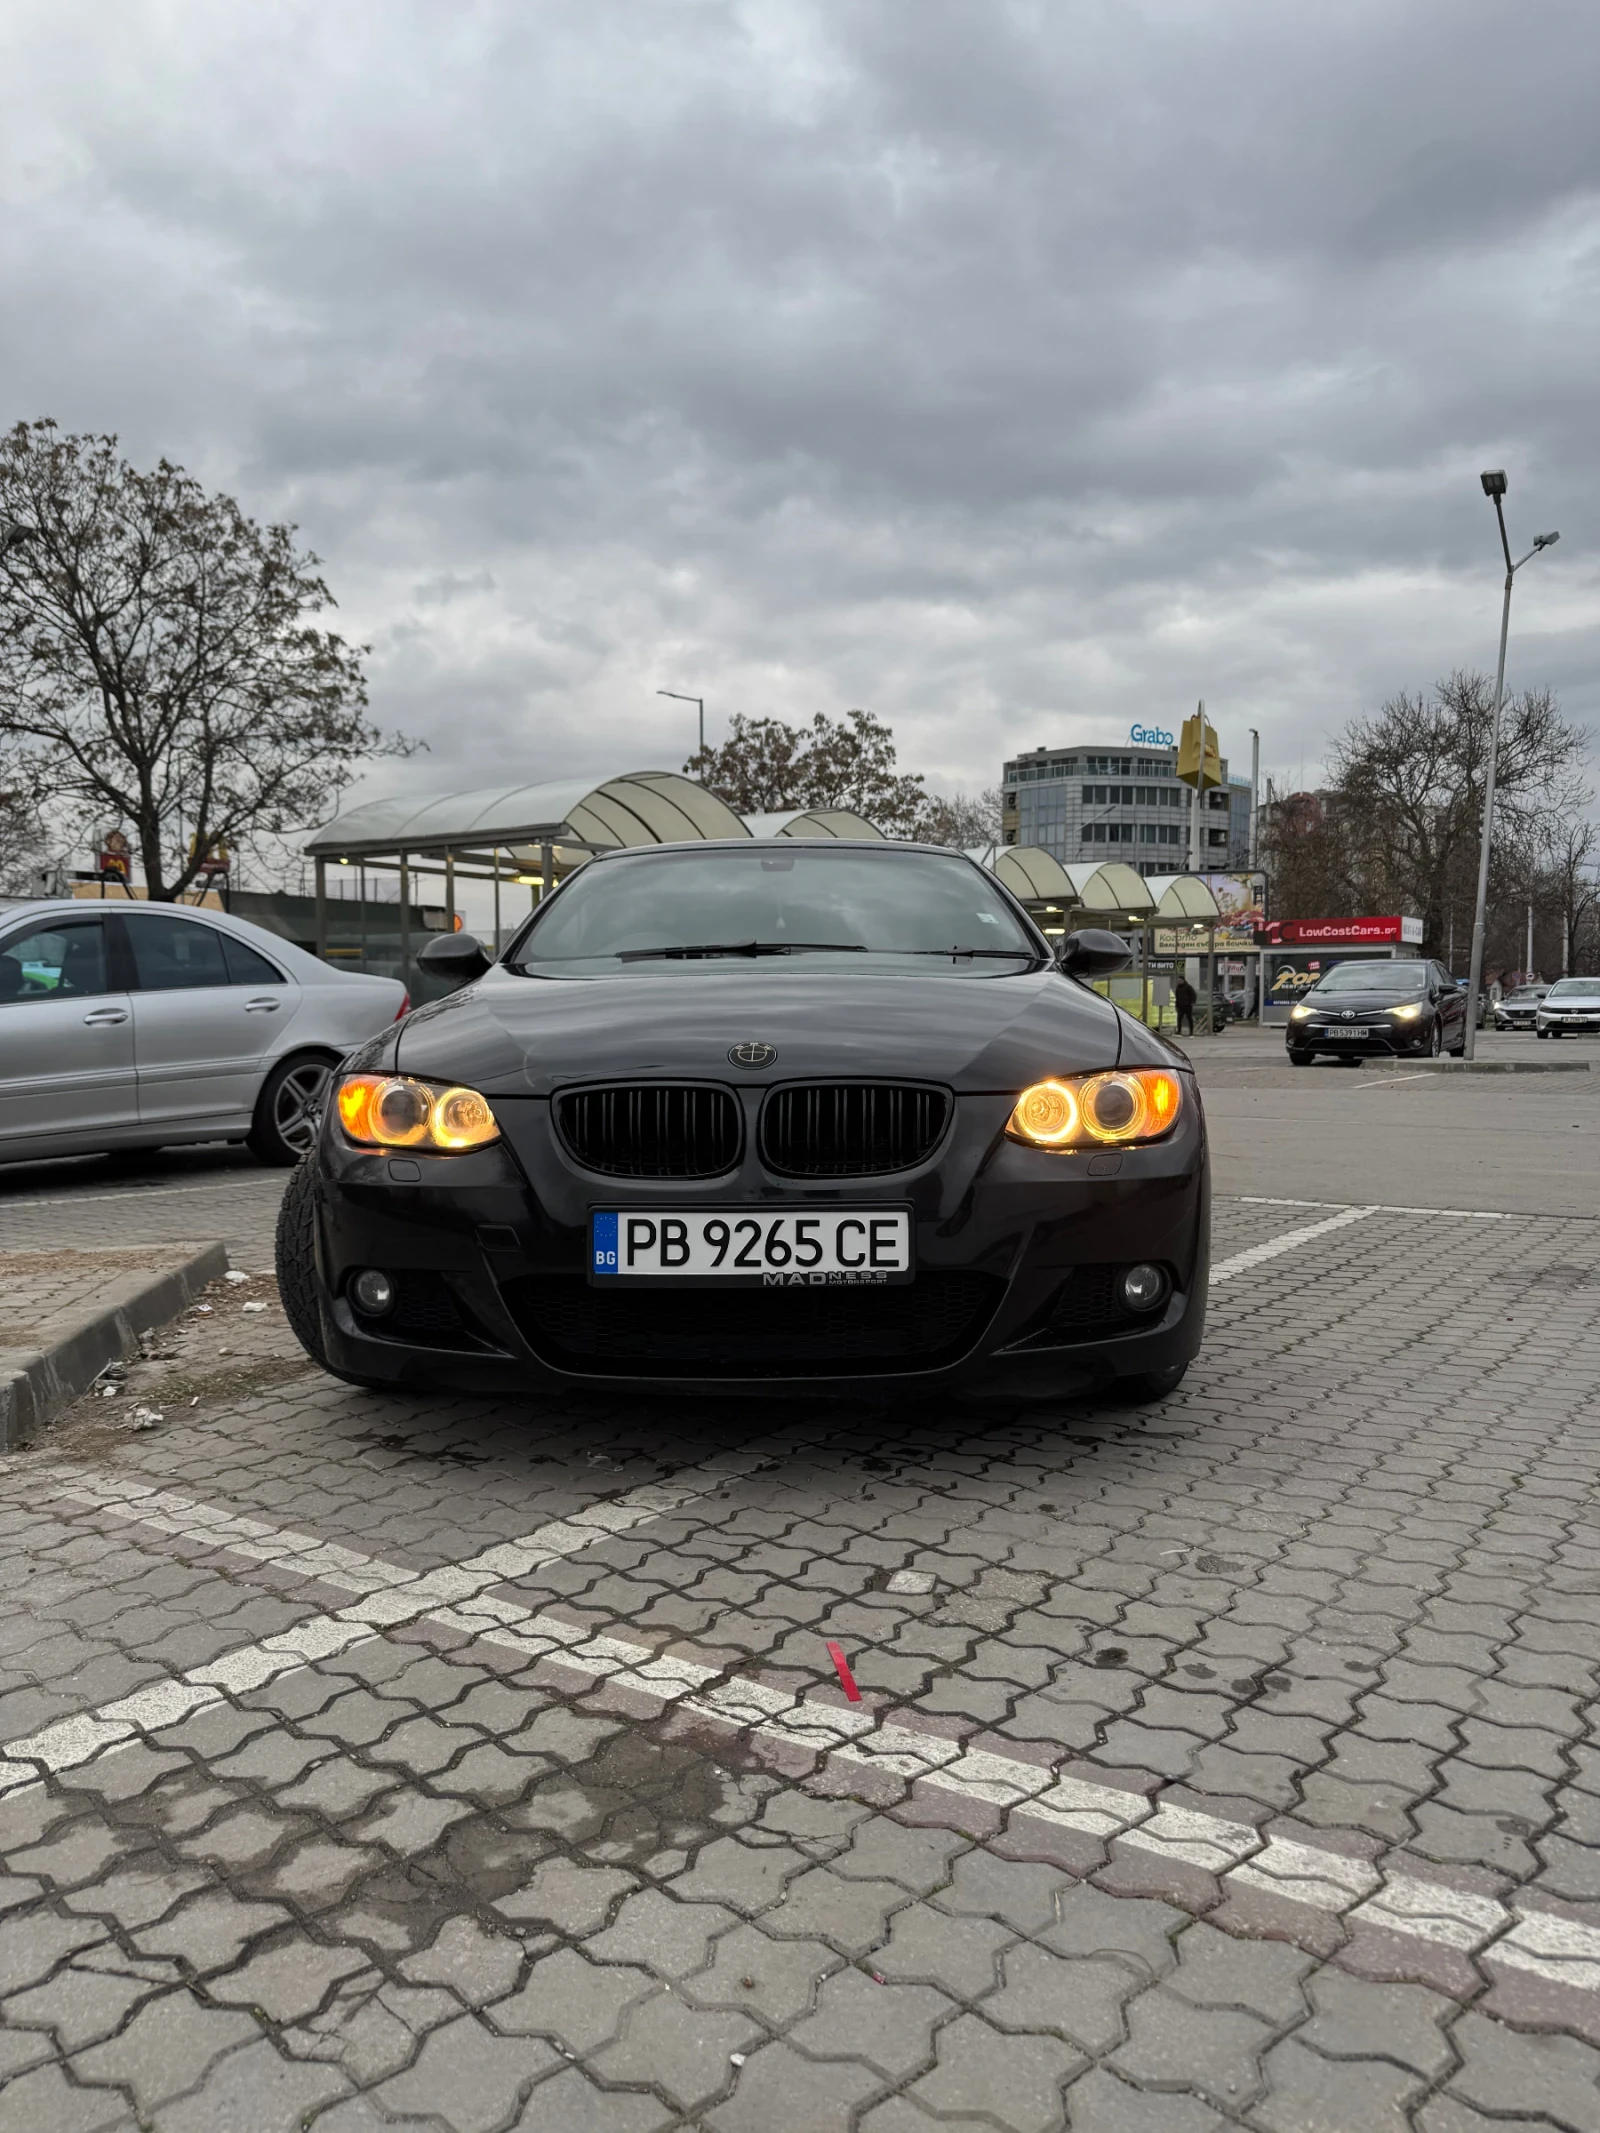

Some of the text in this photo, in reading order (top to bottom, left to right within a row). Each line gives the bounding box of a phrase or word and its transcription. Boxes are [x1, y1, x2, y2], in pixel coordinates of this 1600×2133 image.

[1131, 724, 1173, 745] Grabo
[1270, 972, 1321, 991] TOP
[627, 1218, 900, 1268] PB 9265 CE
[595, 1250, 616, 1266] BG
